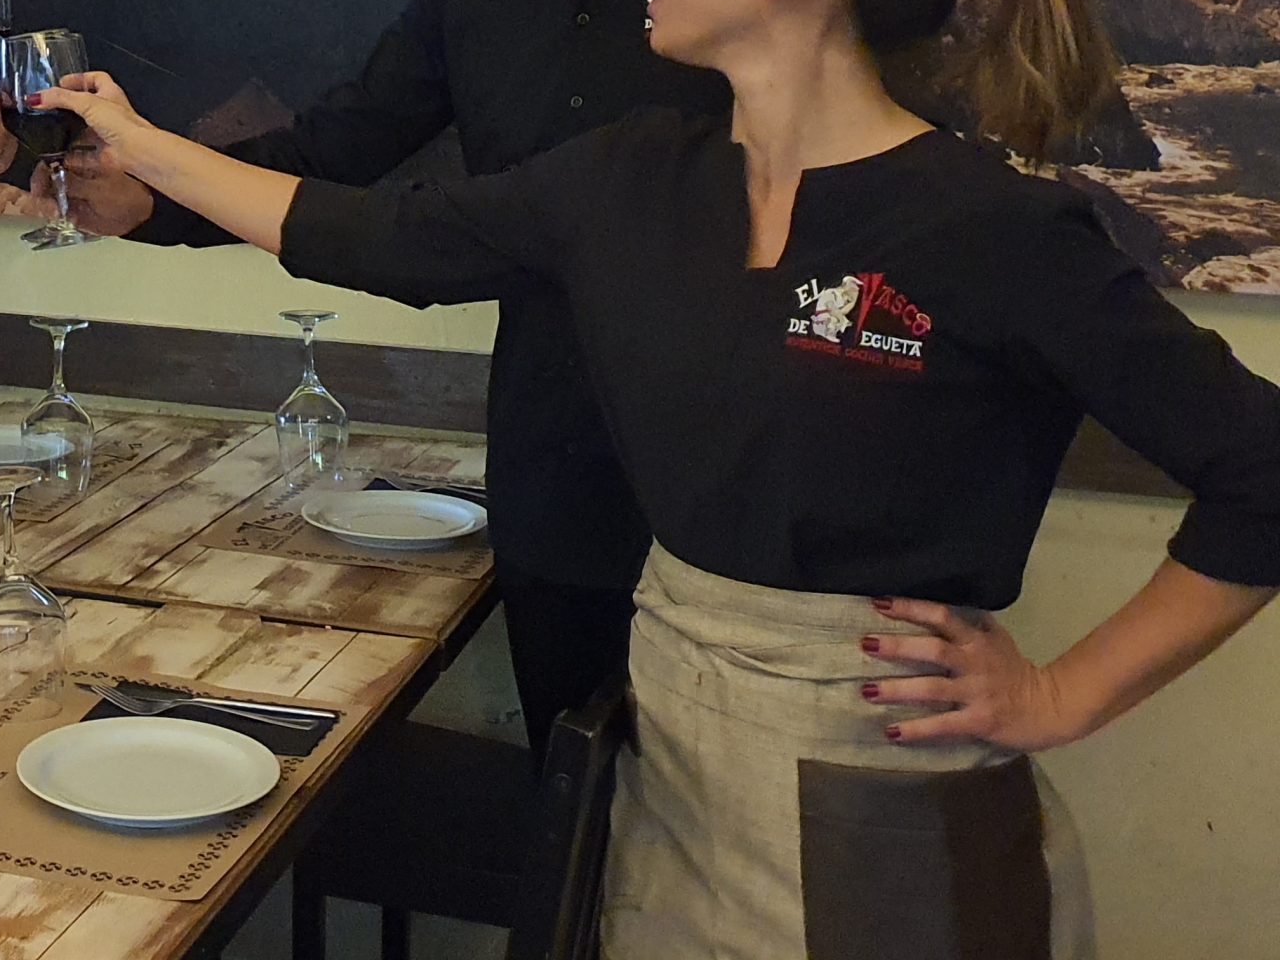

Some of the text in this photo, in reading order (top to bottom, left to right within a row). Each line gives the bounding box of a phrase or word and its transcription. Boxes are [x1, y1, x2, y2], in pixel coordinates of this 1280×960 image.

[795, 272, 932, 338] EL VASCO
[788, 318, 810, 334] DE
